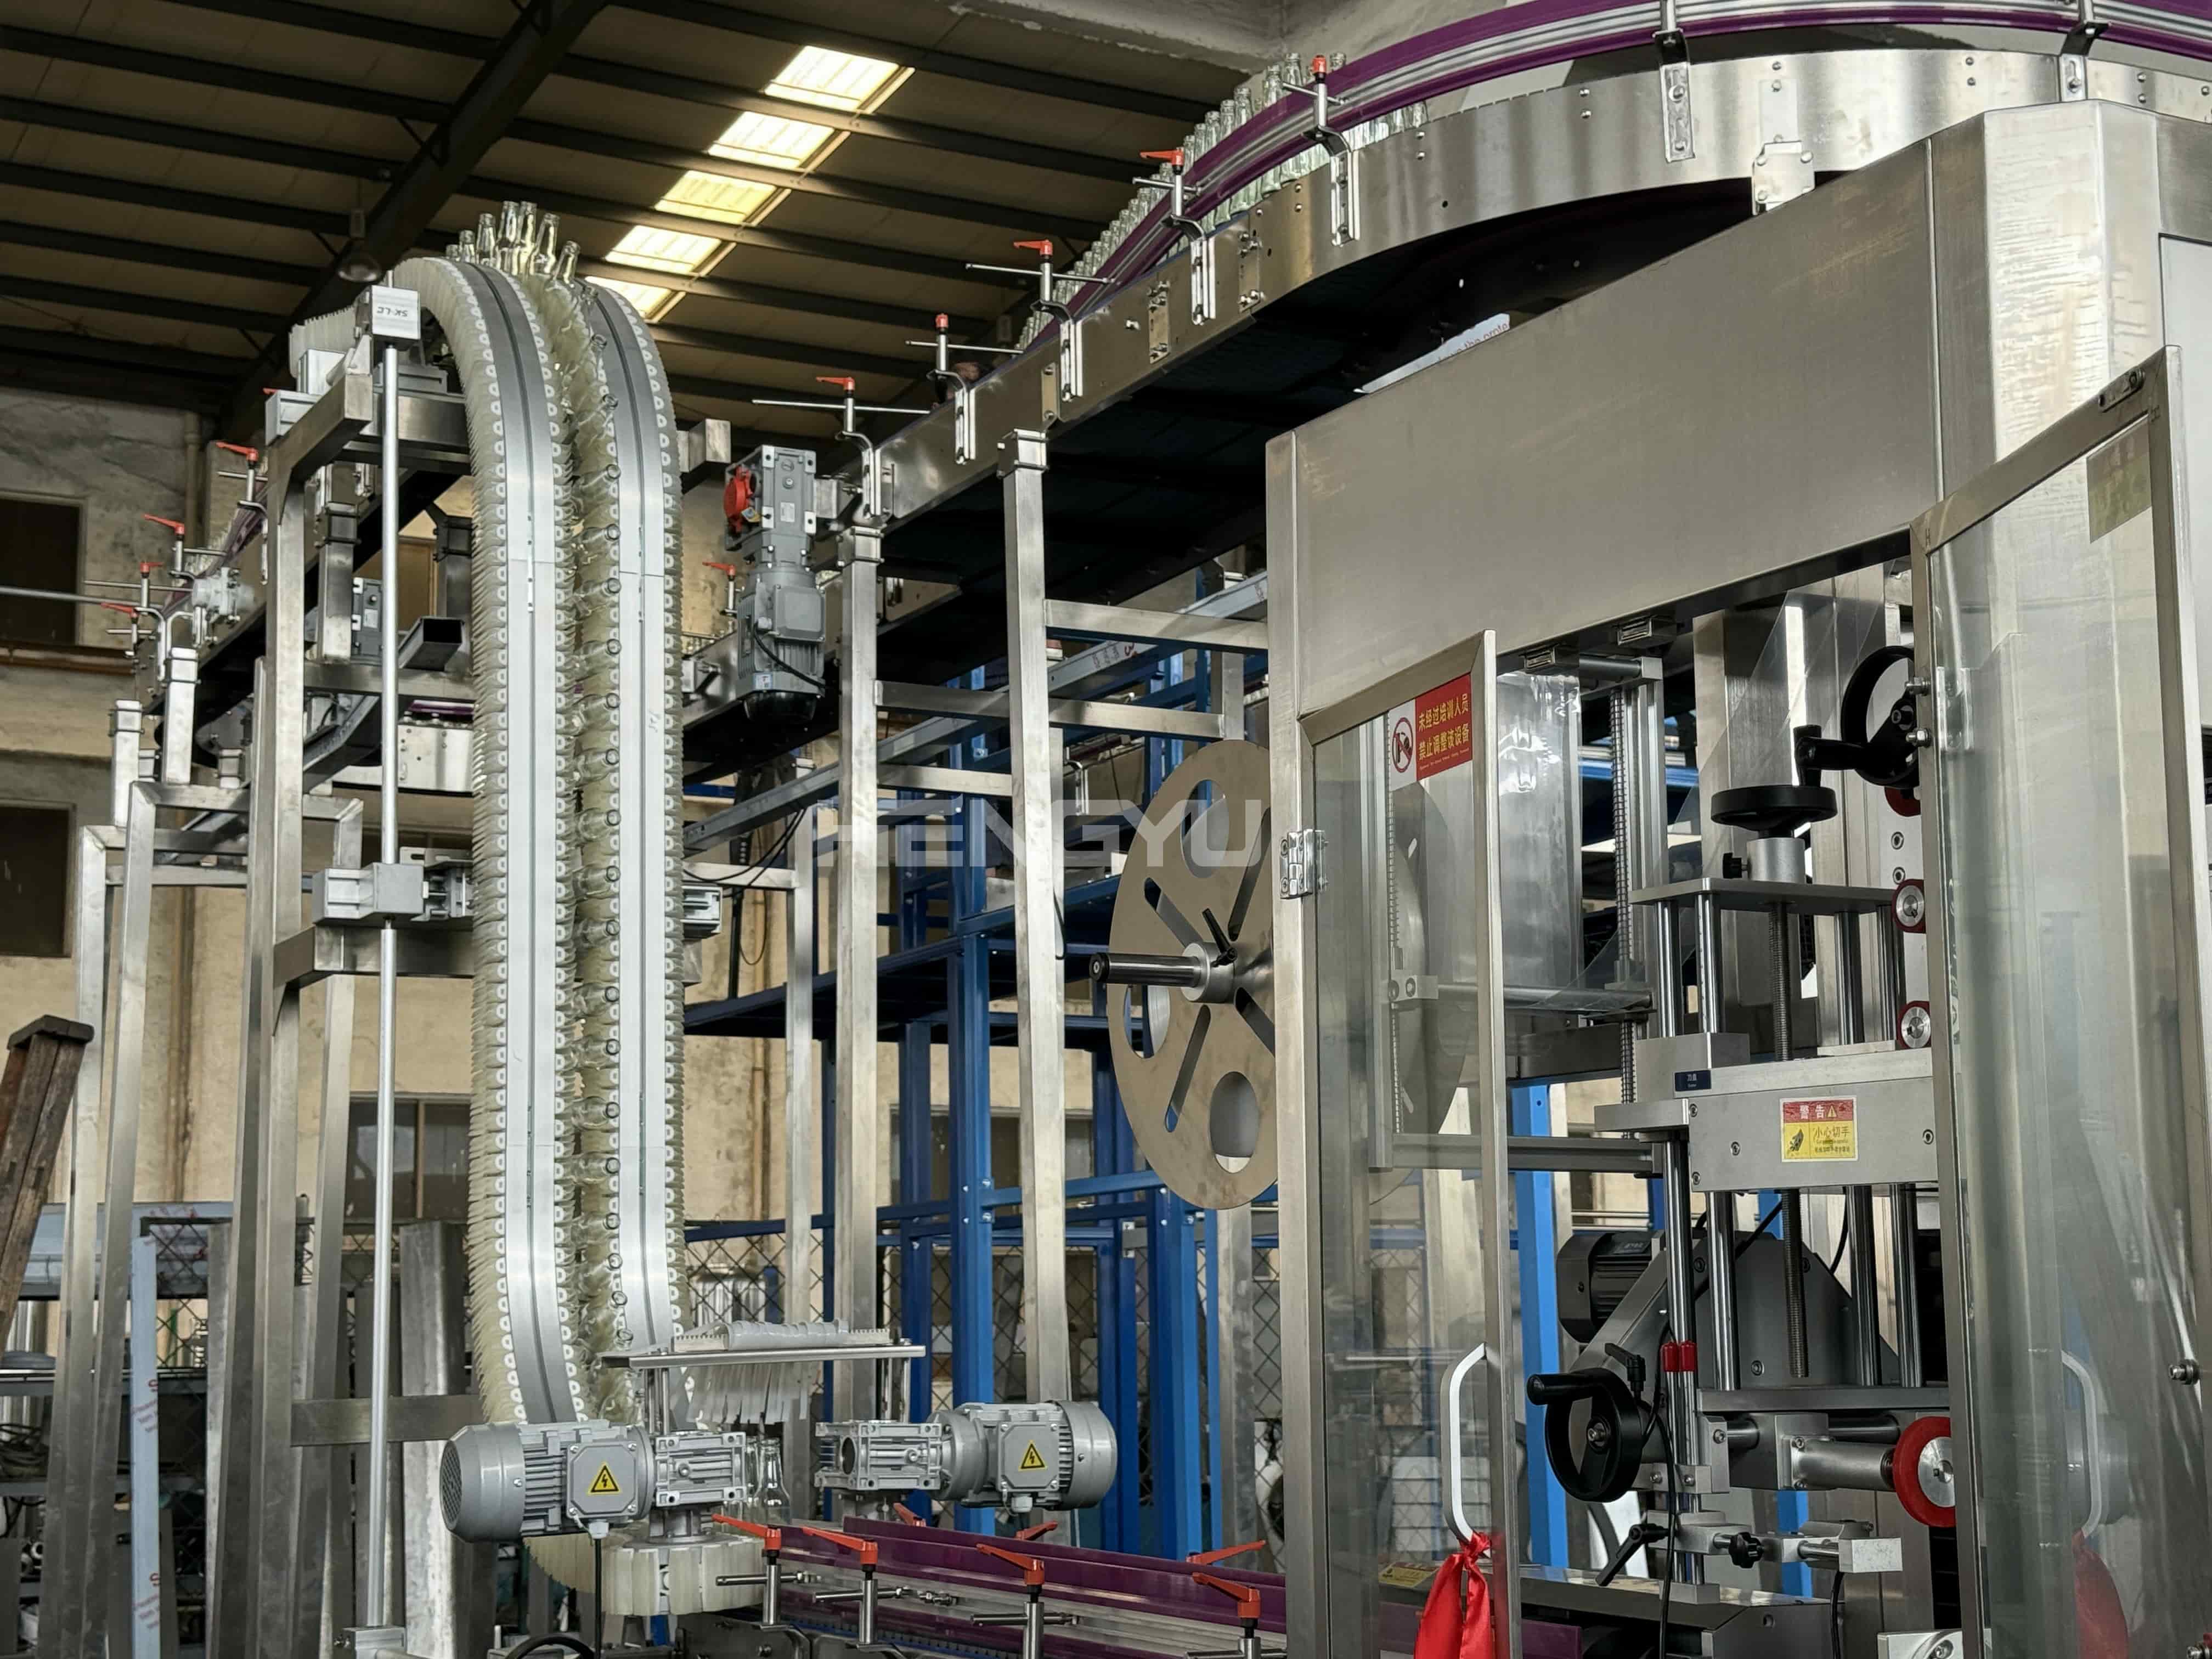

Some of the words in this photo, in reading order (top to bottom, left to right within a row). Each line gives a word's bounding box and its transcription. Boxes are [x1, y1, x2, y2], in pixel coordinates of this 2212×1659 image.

[1799, 1104, 1825, 1120] 警告
[1814, 1126, 1850, 1138] 小心切手
